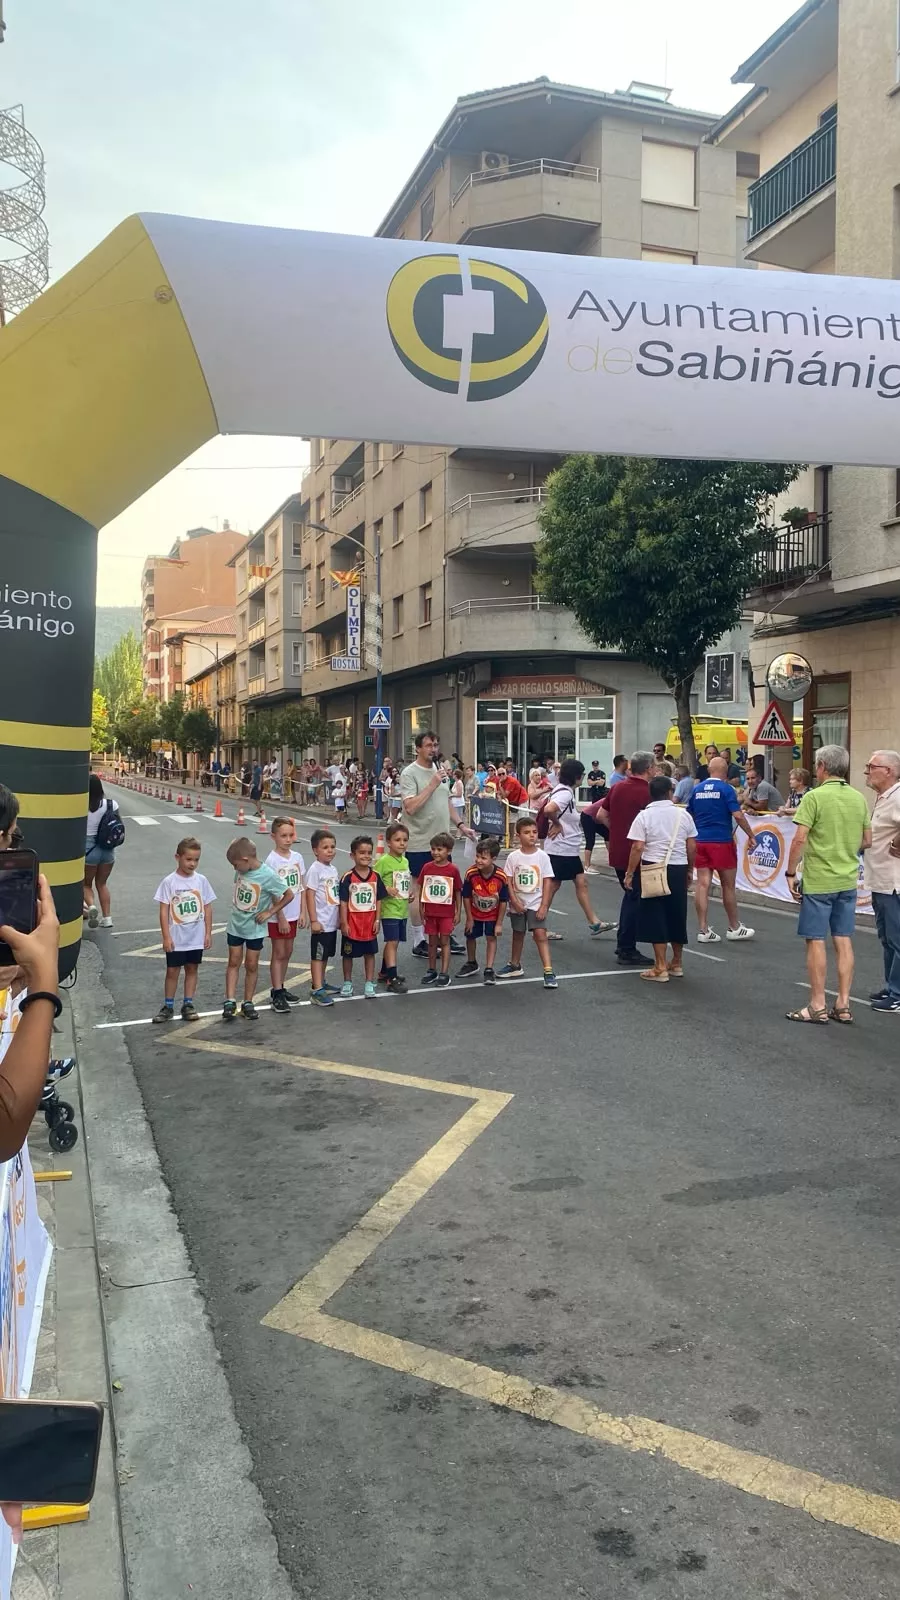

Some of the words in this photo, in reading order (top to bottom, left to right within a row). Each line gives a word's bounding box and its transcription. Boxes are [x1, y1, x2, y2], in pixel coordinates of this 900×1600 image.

[567, 290, 900, 342] Ayuntamient
[0, 584, 72, 610] iento
[349, 588, 359, 656] OLIMPIC
[333, 658, 359, 670] HOSTAL
[492, 683, 518, 696] BAZAR
[520, 682, 552, 695] REGALO
[284, 873, 299, 887] 197
[518, 874, 534, 885] 151
[429, 884, 447, 897] 188
[355, 892, 372, 904] 162
[177, 900, 198, 915] 146
